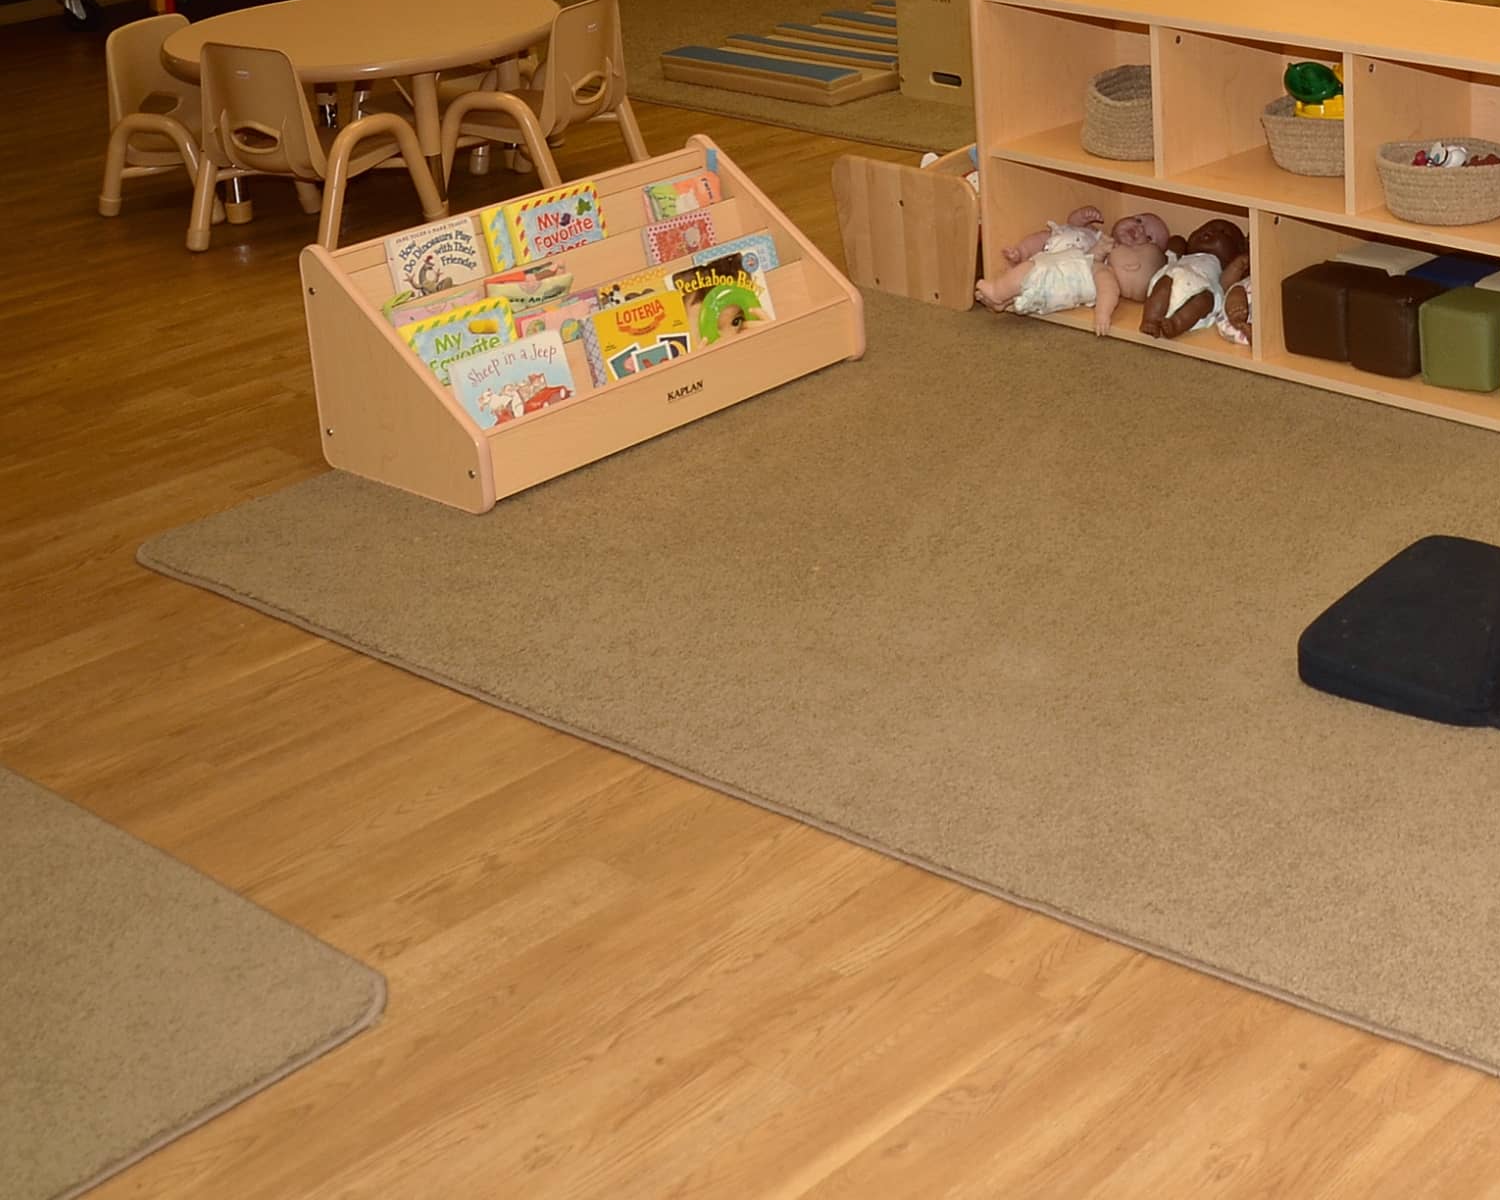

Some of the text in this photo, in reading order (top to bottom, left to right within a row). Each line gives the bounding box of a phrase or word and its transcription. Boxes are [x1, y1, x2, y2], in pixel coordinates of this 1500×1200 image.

[537, 211, 561, 231] My
[534, 216, 593, 252] Favorite
[398, 240, 417, 261] How
[404, 230, 472, 273] Do Dinosaurs Play
[434, 242, 476, 256] with Their
[440, 254, 477, 270] Friends?
[675, 268, 734, 296] Peekaboo
[616, 299, 665, 325] LOTERIA
[434, 332, 462, 354] My
[467, 343, 557, 387] Sheep in a Jeep
[666, 380, 704, 401] KAPLAN
